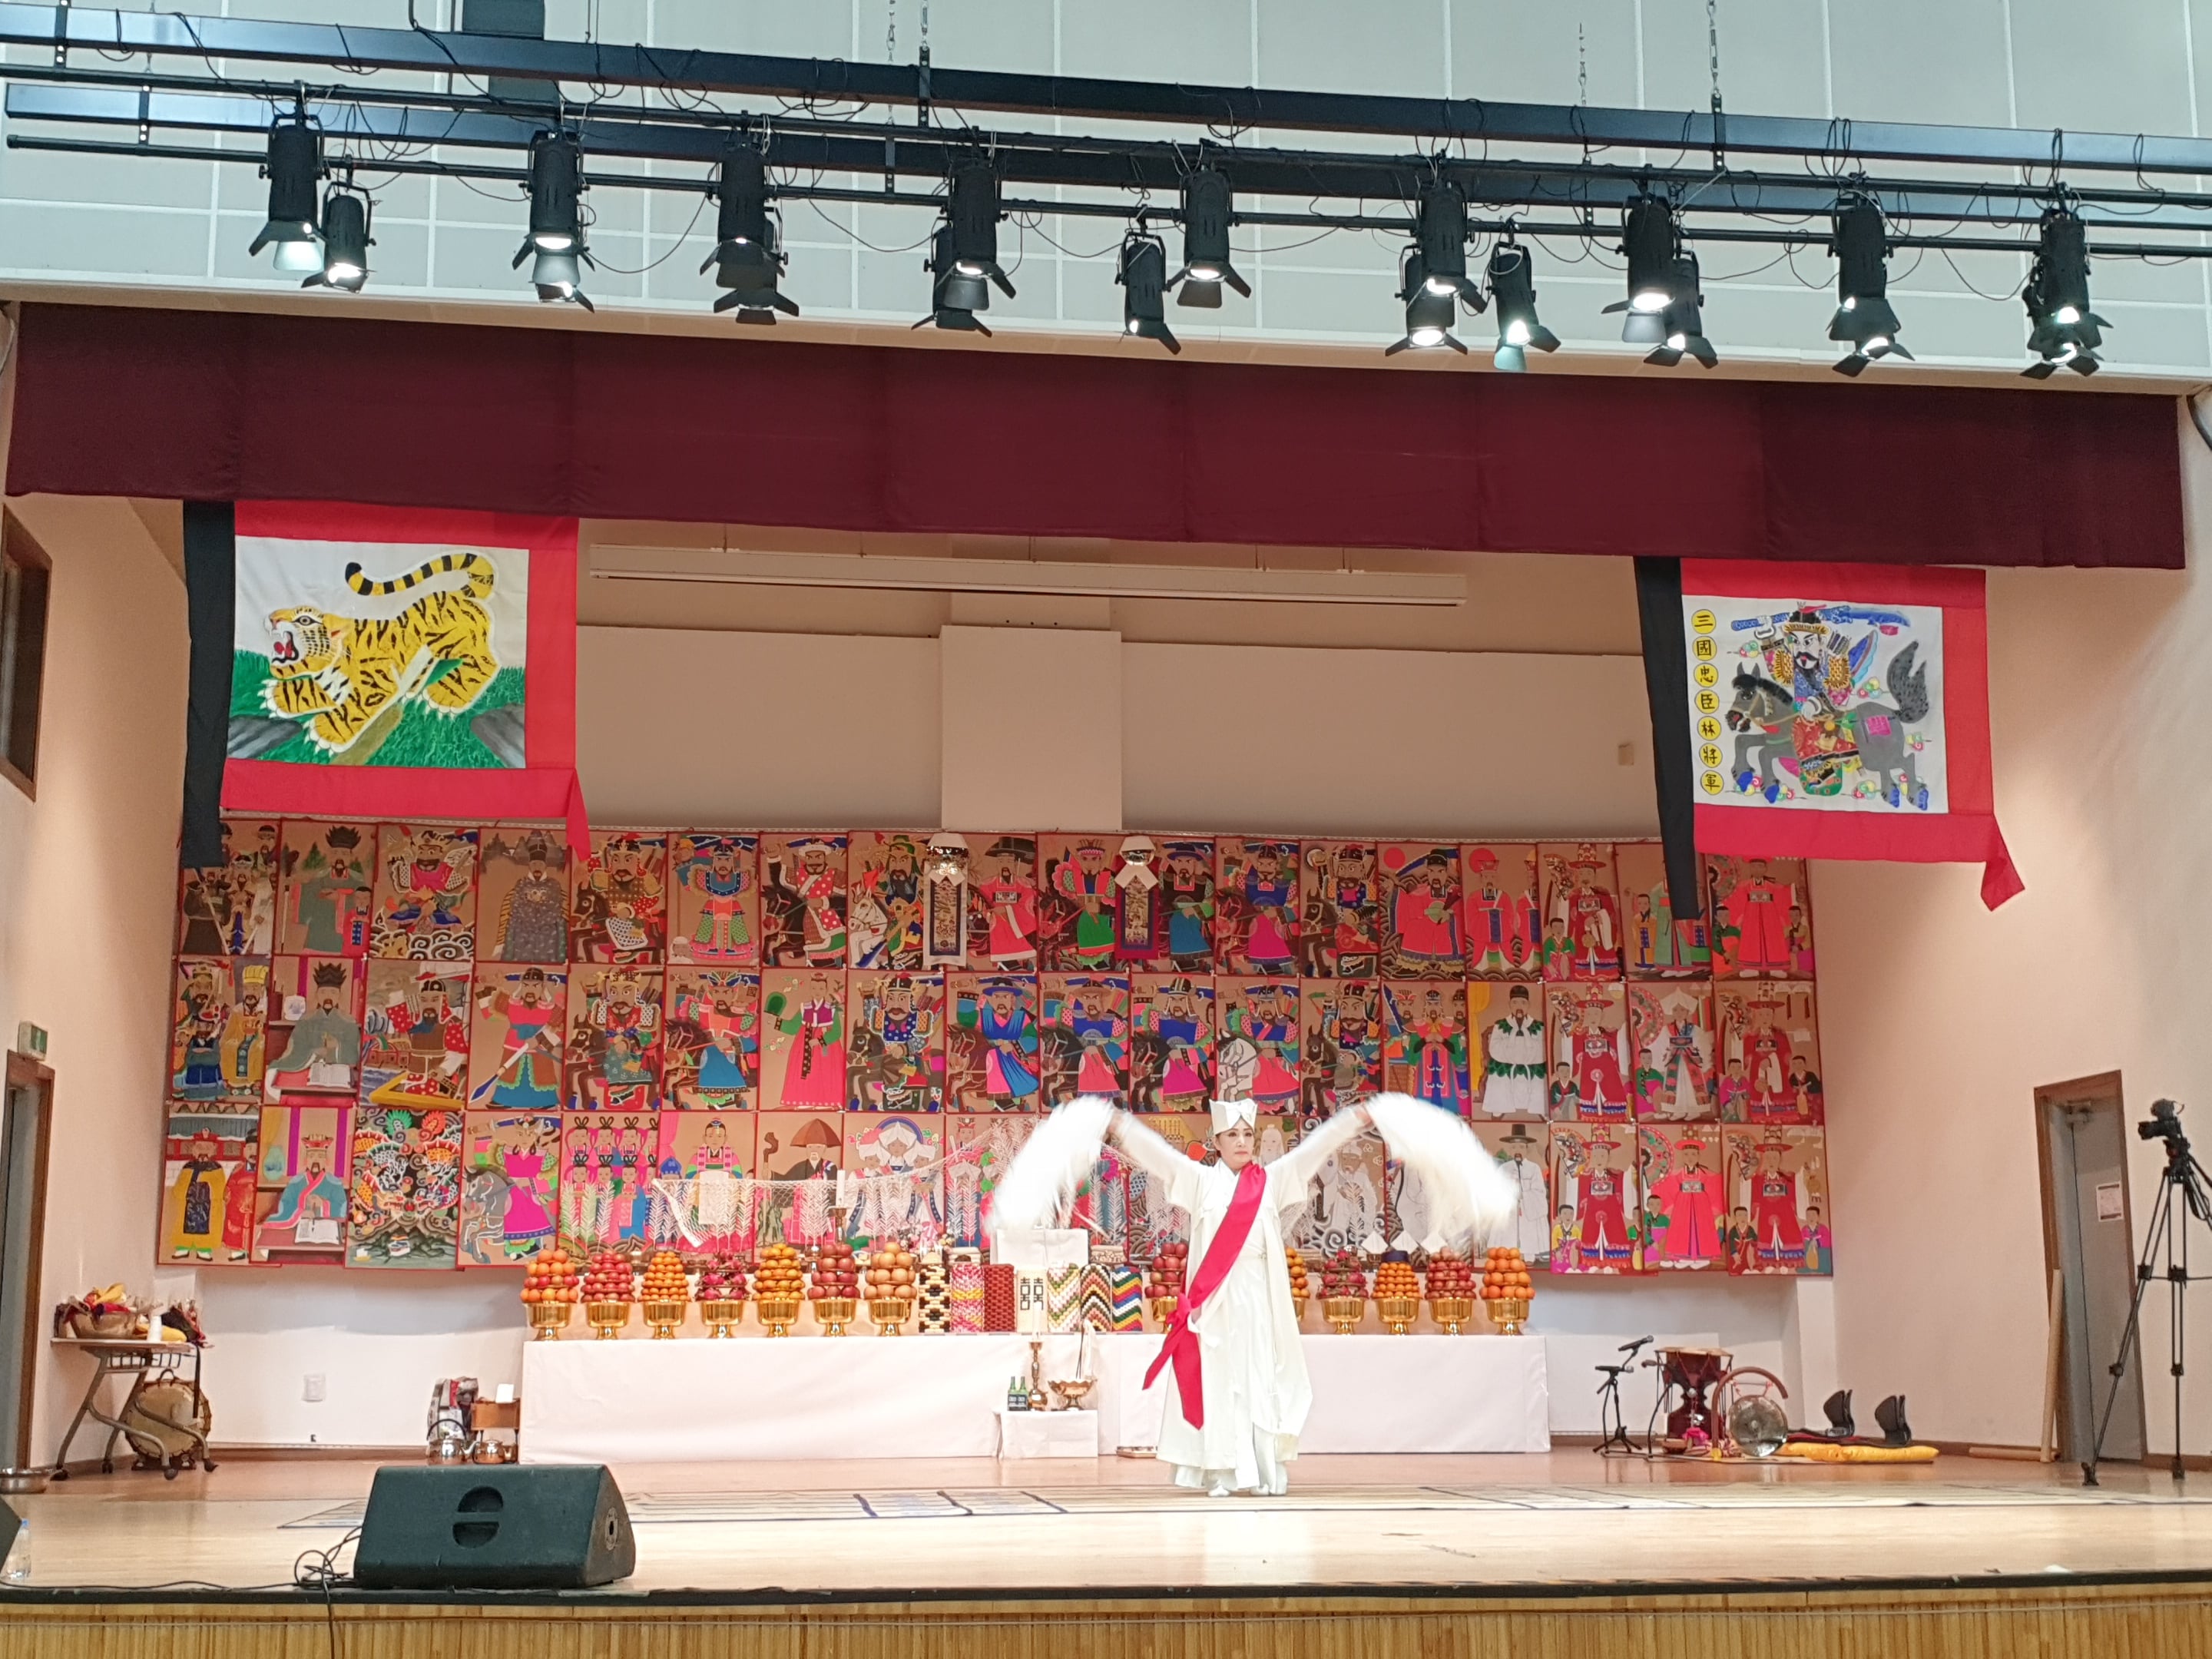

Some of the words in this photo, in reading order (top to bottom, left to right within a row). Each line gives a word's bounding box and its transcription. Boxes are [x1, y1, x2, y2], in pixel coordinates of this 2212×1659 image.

[1694, 614, 1720, 790] 三國忠臣林將軍
